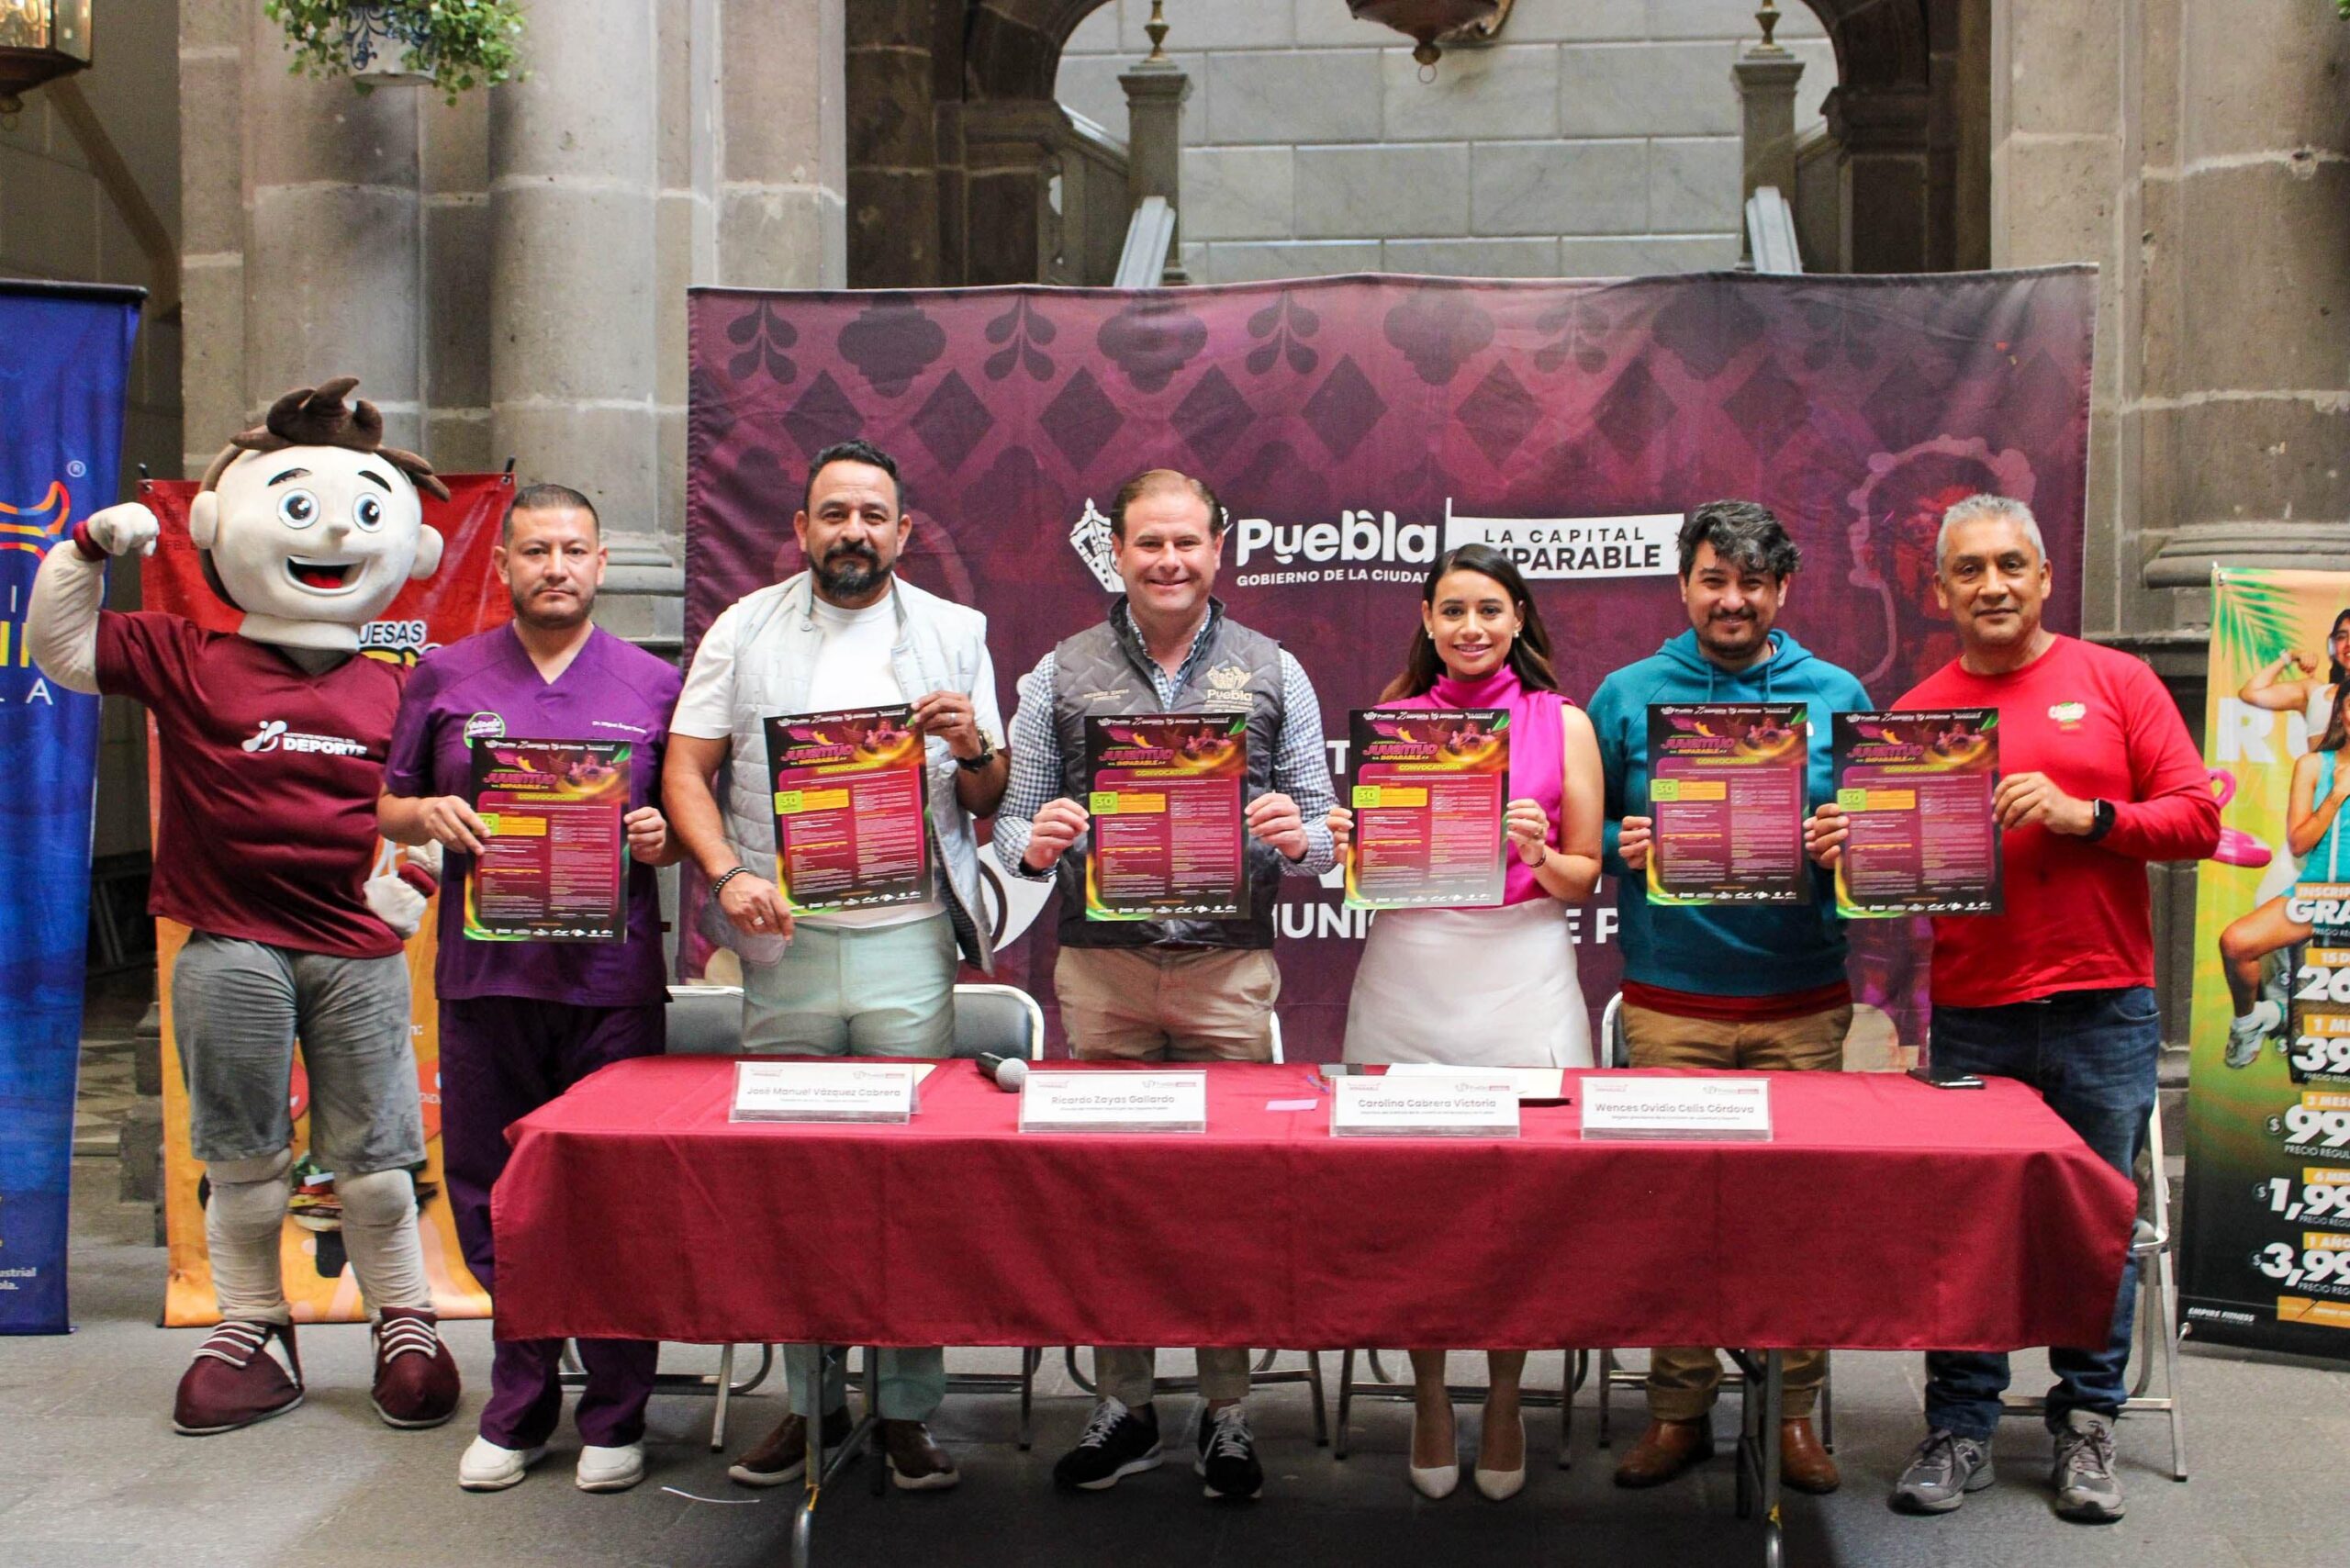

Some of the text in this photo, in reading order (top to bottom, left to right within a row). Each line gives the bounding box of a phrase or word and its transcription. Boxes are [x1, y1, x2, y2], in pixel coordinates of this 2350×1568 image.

[1237, 510, 1438, 566] Puebla
[1484, 526, 1644, 543] LA CAPITAL
[1499, 543, 1661, 571] PARABLE
[1237, 570, 1320, 587] GOBIERNO
[1324, 569, 1345, 581] DE
[1348, 568, 1368, 581] LA
[1207, 689, 1253, 701] Puebla
[773, 1087, 811, 1096] Manuel
[1051, 1095, 1175, 1106] Ricardo Zayas Gallardo
[1358, 1098, 1496, 1108] Carolina Cabrera Victoria
[1595, 1103, 1639, 1113] Wences
[1640, 1103, 1676, 1113] Ovidio
[2284, 1144, 2319, 1156] PRECIO
